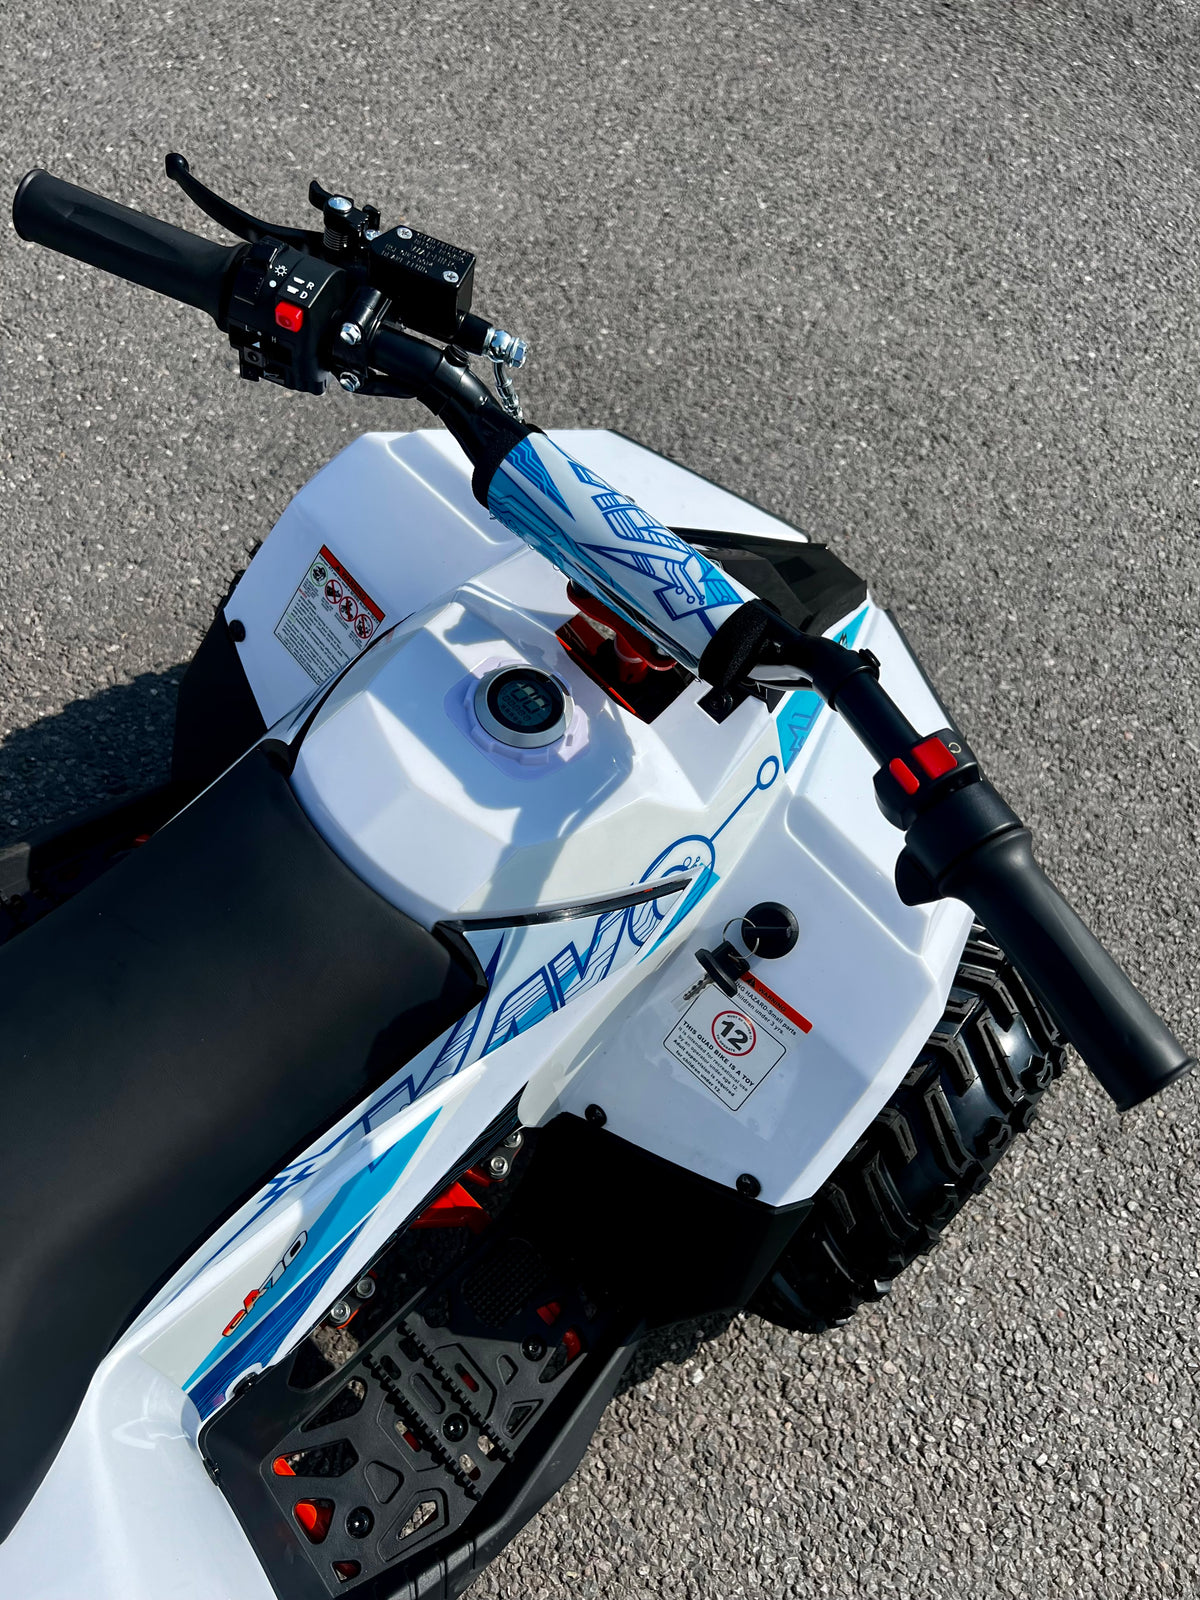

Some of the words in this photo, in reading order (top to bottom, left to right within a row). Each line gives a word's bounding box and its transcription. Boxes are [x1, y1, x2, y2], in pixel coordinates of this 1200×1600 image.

[299, 291, 309, 300] D
[306, 282, 315, 291] R
[736, 992, 755, 1010] hildren
[755, 1008, 770, 1023] under
[774, 1025, 785, 1035] yrs.
[758, 987, 787, 1012] WARNING
[720, 1022, 751, 1051] 12
[782, 1022, 797, 1036] parts
[672, 1038, 686, 1052] Adult
[684, 1050, 711, 1076] supervision
[715, 1078, 735, 1098] required
[675, 1049, 683, 1058] for
[682, 1056, 702, 1075] children
[700, 1072, 715, 1087] under
[714, 1085, 722, 1094] 12.
[677, 1034, 685, 1043] by
[689, 1046, 710, 1066] operator
[709, 1063, 723, 1077] under
[721, 1076, 731, 1086] age
[731, 1083, 739, 1092] 12.
[682, 1020, 697, 1035] THIS
[696, 1033, 714, 1050] QUAD
[713, 1049, 729, 1064] BIKE
[729, 1062, 736, 1071] IS
[741, 1074, 755, 1087] TOY
[686, 1034, 707, 1054] intended
[706, 1051, 714, 1060] for
[713, 1058, 740, 1084] recreational
[739, 1083, 748, 1092] use
